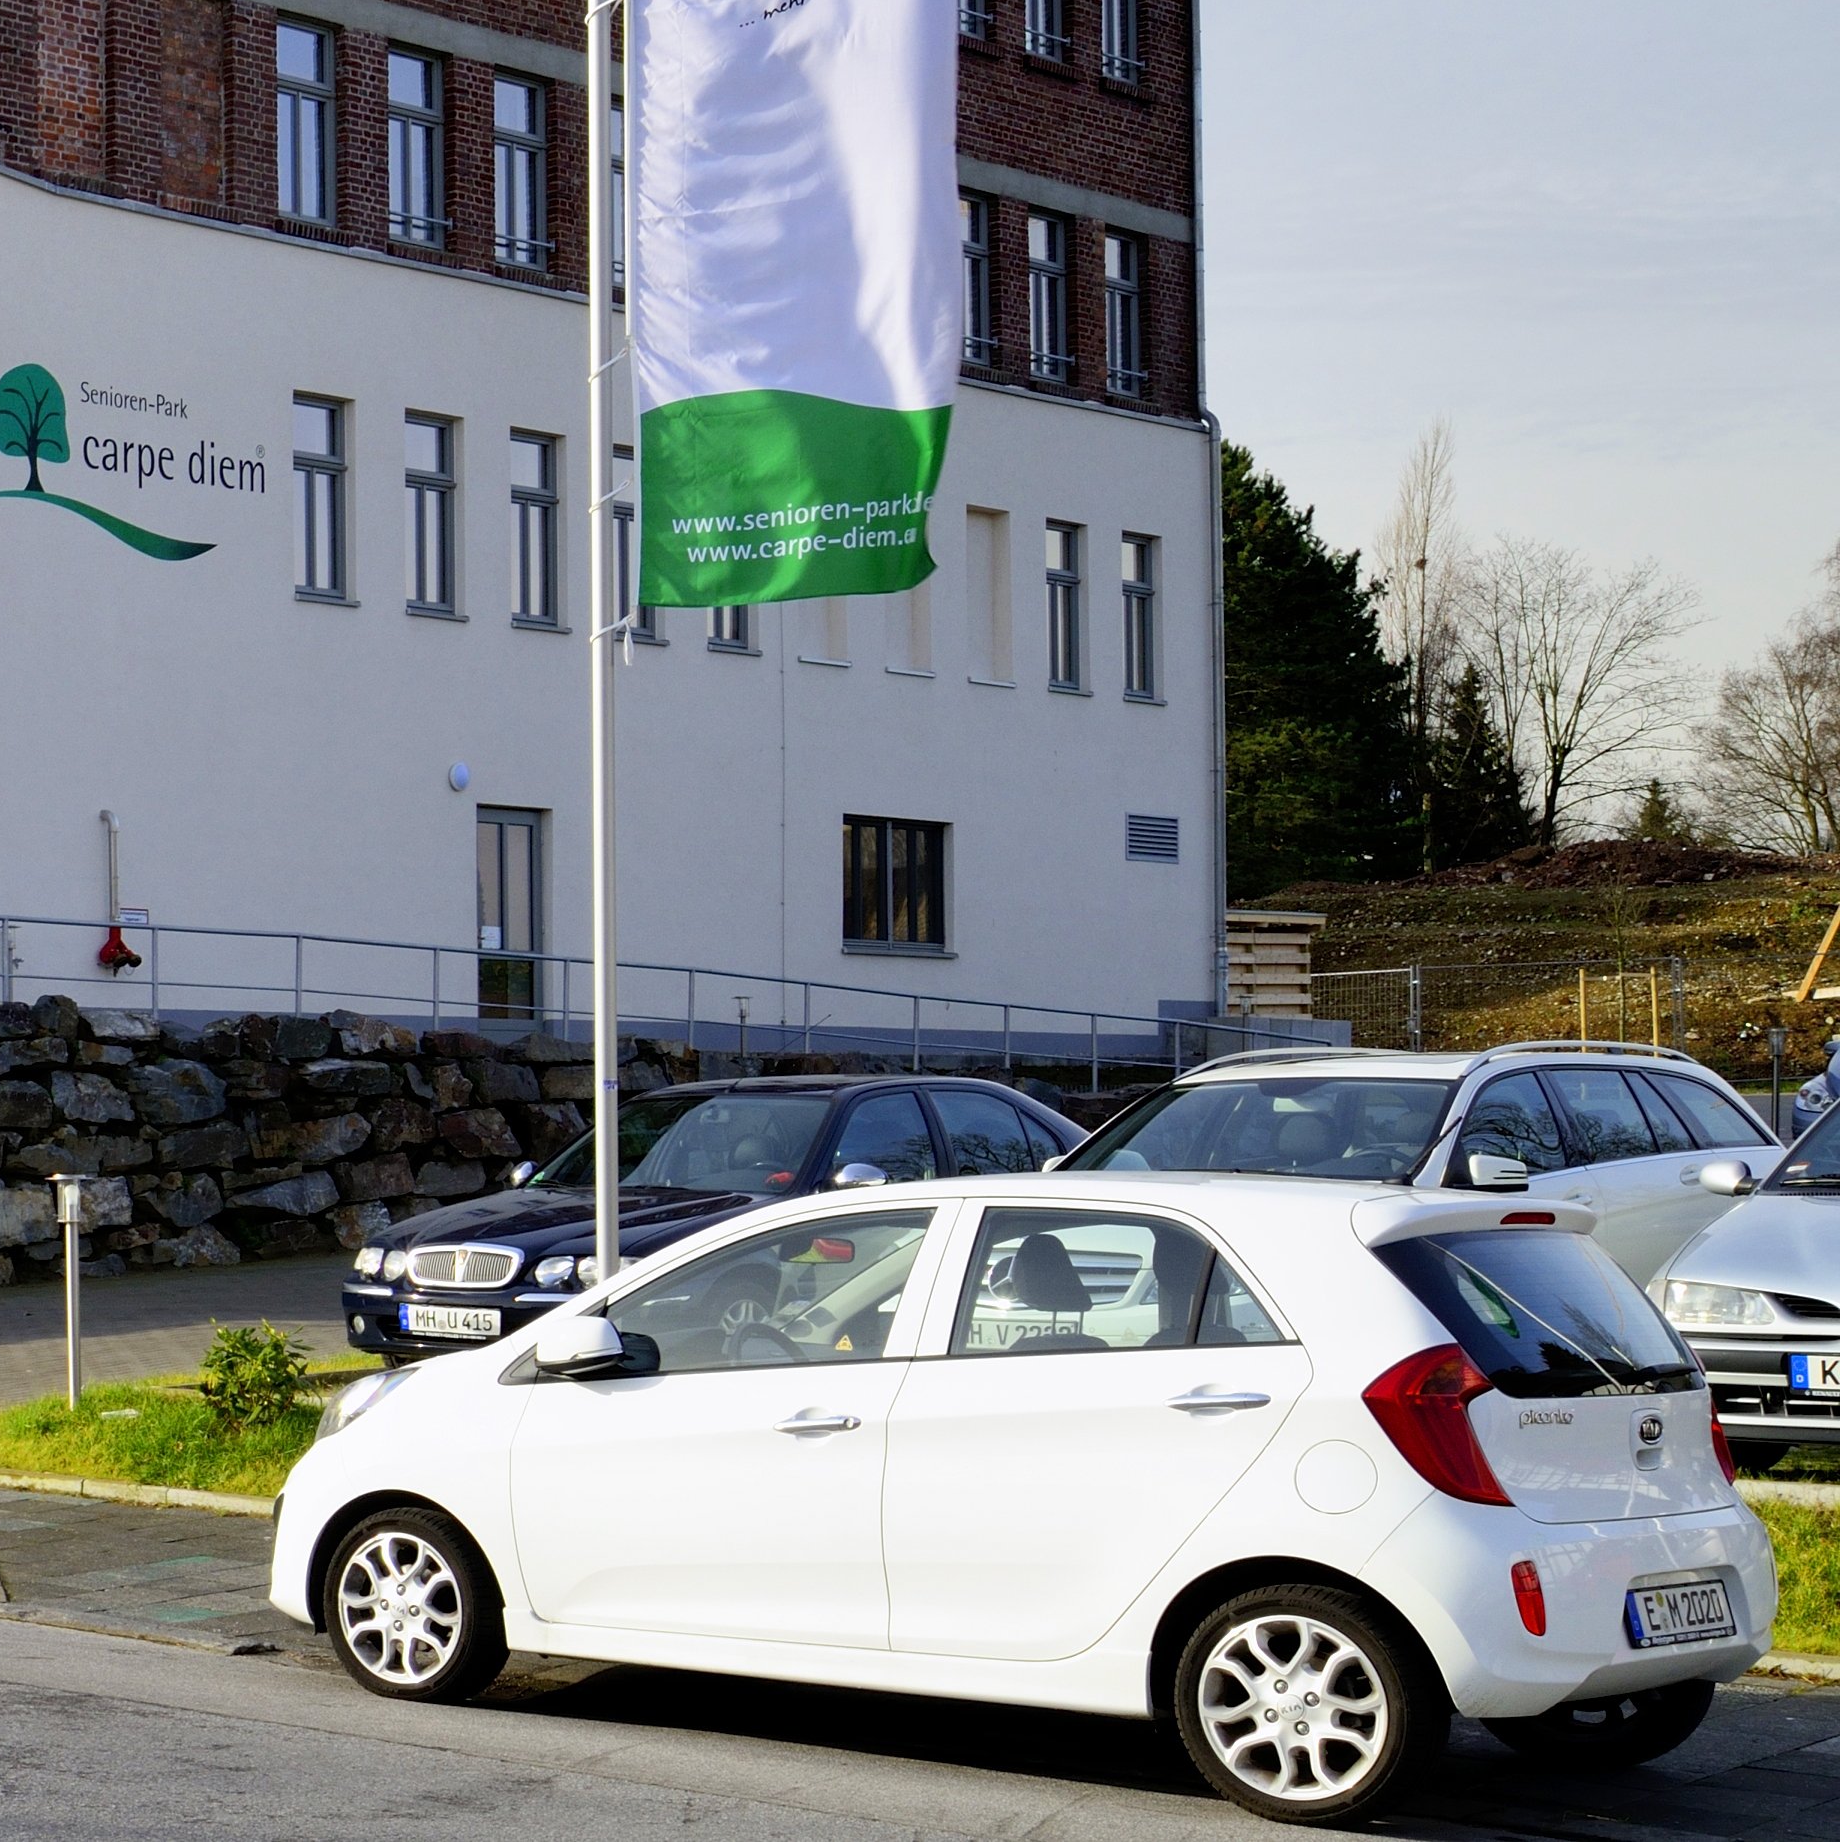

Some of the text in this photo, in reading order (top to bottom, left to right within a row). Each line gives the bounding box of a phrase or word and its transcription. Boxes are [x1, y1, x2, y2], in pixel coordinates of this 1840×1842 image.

[80, 381, 188, 419] Senioren-Park
[83, 436, 174, 489] carpe
[415, 1310, 493, 1332] MH U 415
[1519, 1409, 1574, 1429] picanto
[1643, 1588, 1725, 1632] E M 2020
